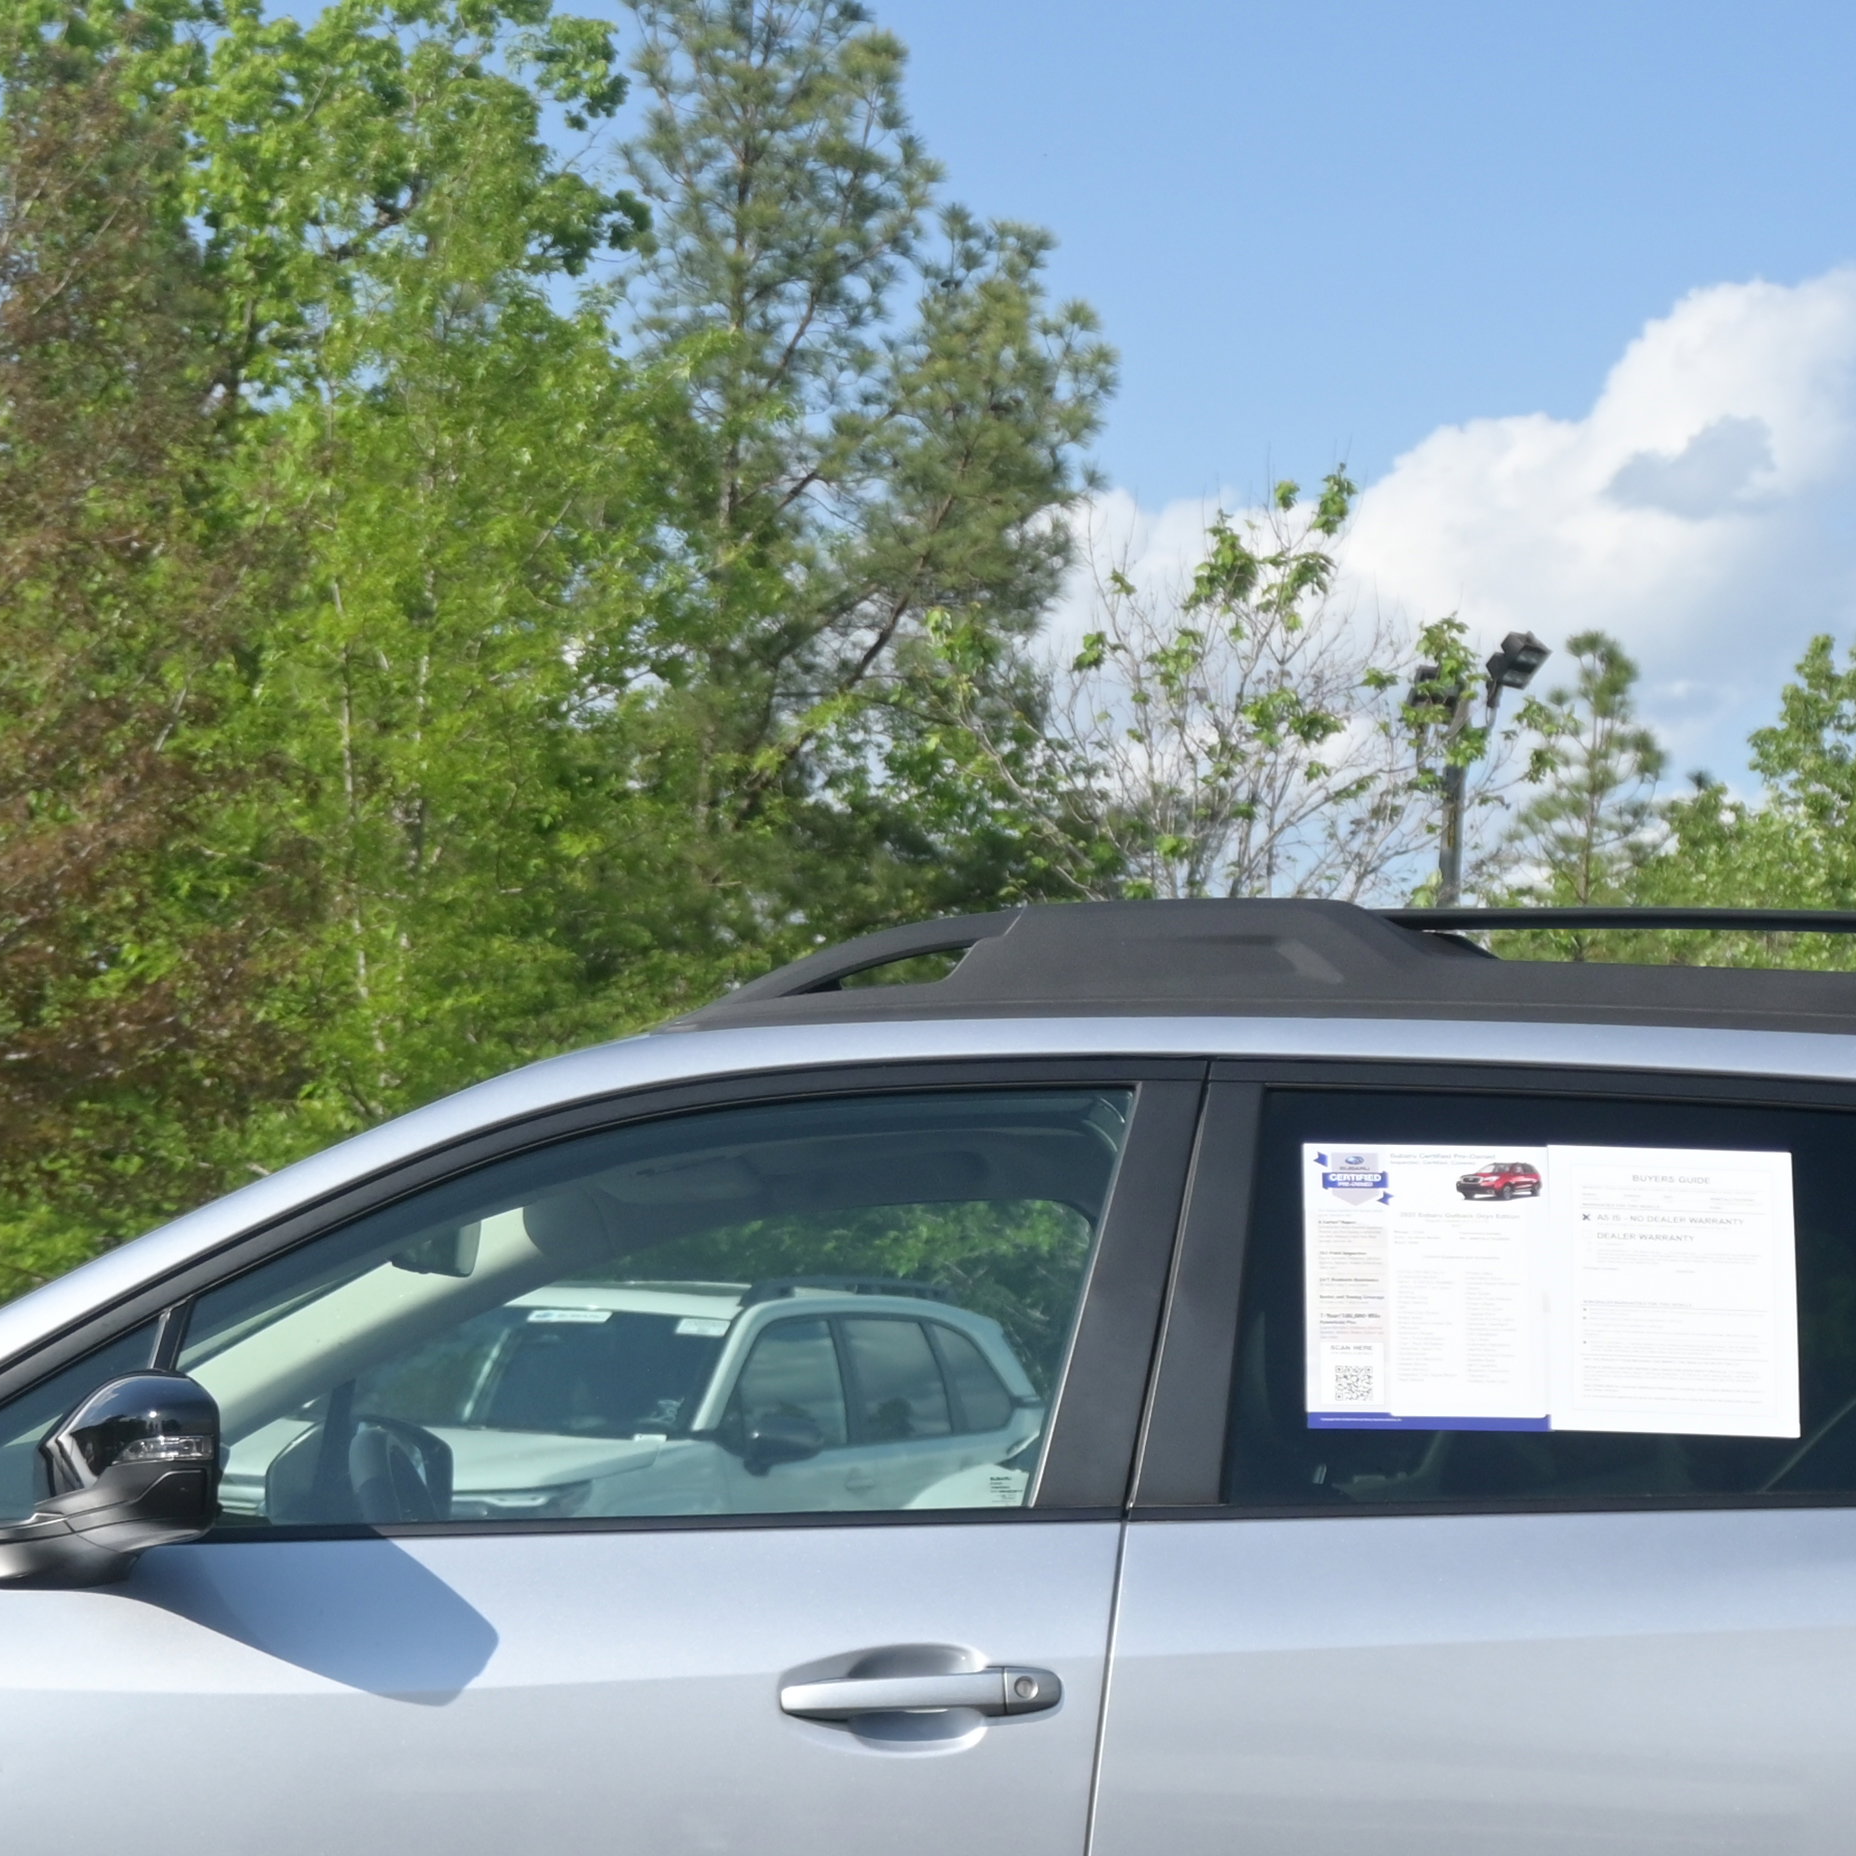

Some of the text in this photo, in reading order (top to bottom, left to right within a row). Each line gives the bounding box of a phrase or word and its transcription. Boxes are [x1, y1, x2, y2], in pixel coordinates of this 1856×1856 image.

[1329, 1173, 1382, 1182] CERTIFIED
[1632, 1174, 1711, 1184] BUYERS GUIDE
[1630, 1215, 1644, 1223] NO
[1647, 1215, 1686, 1224] DEALER
[1689, 1217, 1745, 1226] WARRANTY
[1597, 1232, 1695, 1242] DEALER WARRANTY
